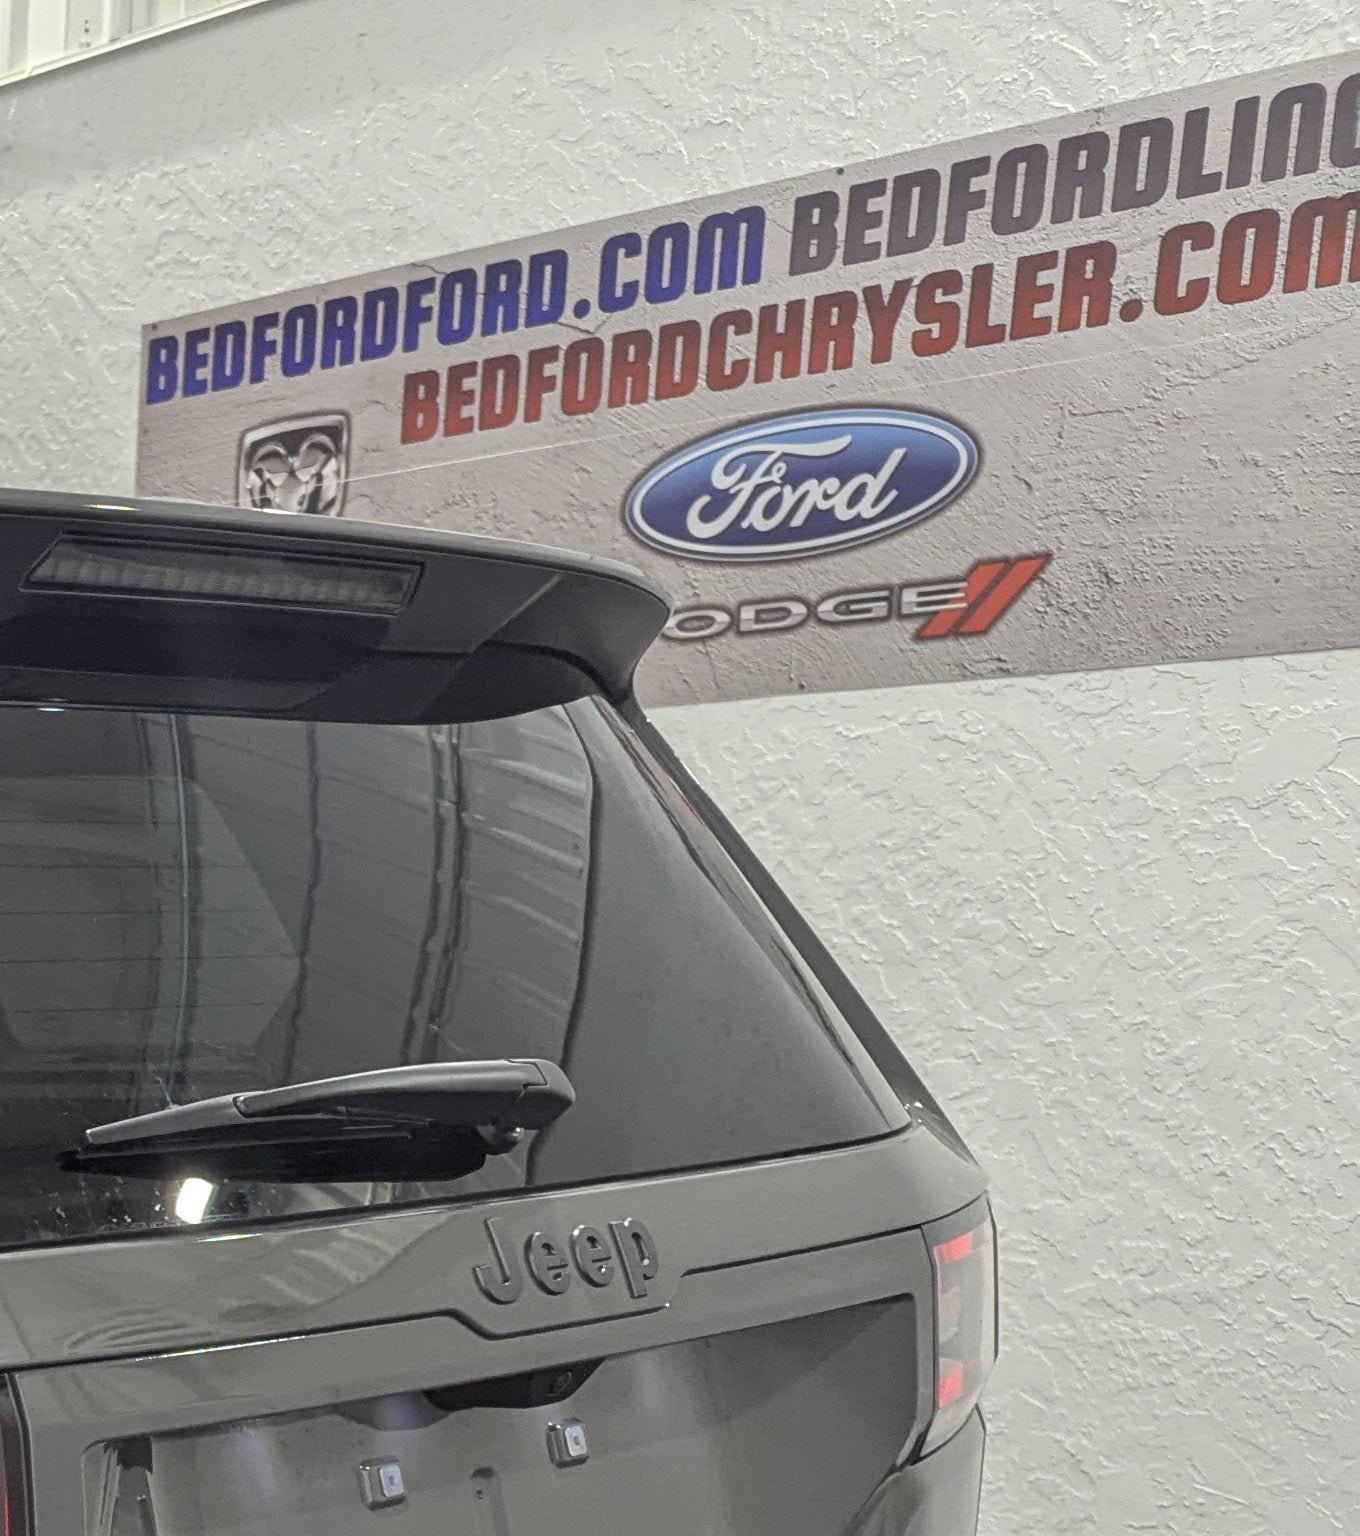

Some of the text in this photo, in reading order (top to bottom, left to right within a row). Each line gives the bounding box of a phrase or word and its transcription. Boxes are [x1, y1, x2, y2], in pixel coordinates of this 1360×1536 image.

[145, 204, 767, 406] BEDFORDFORD.COM
[400, 190, 1360, 446] BEDFORDCHRYSLER.COM
[685, 433, 910, 540] Ford
[663, 579, 970, 640] ODGE
[471, 1216, 661, 1306] Jeep
